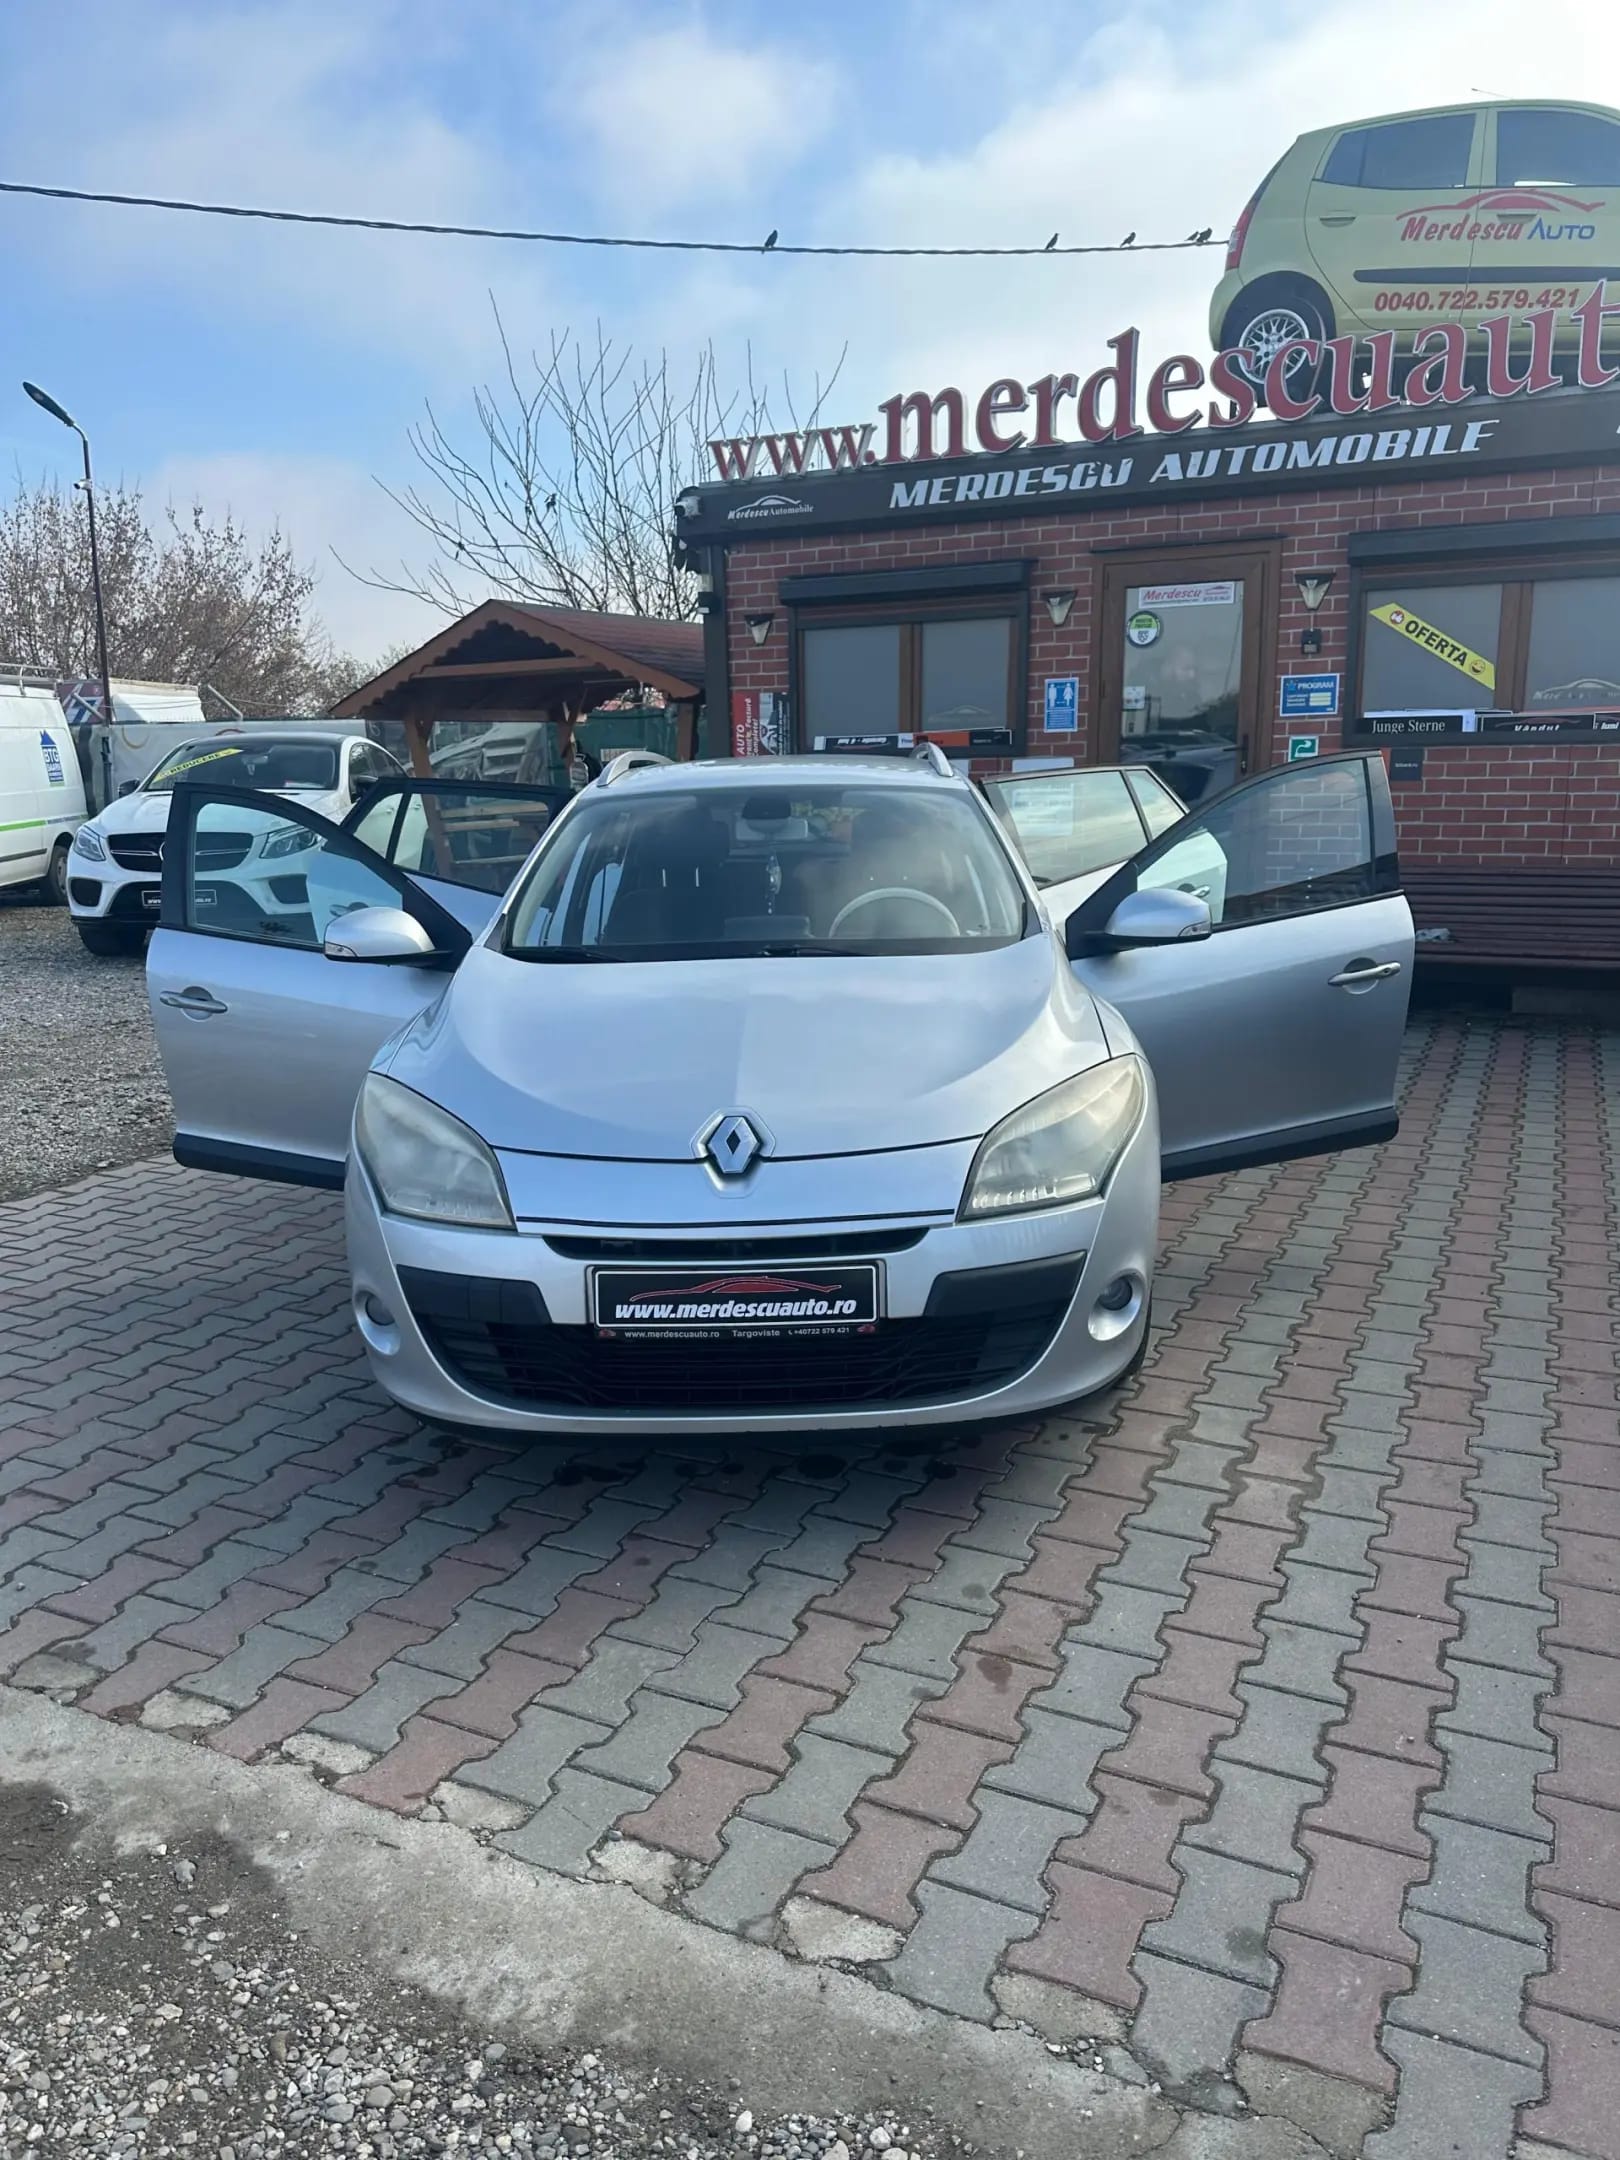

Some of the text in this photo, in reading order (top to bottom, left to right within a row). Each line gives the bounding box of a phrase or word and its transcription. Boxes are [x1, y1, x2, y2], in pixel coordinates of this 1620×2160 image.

[1400, 214, 1596, 241] Merdescu AUTO
[1374, 287, 1580, 312] 0040.722.579.421
[889, 418, 1500, 509] MERDESCU AUTOMOBILE
[728, 503, 814, 520] Merdescu Automobile
[1143, 588, 1202, 601] Merdescu
[1404, 619, 1468, 667] OFERTA
[1297, 681, 1334, 689] PROGRAM
[1371, 719, 1446, 735] Junge Sterne
[736, 724, 745, 755] AUTO
[170, 753, 219, 774] REDUCERE
[615, 1299, 857, 1319] www.merdescuauto.ro
[624, 1330, 720, 1339] www.merdescuauto.ro
[732, 1329, 781, 1339] Targoviste
